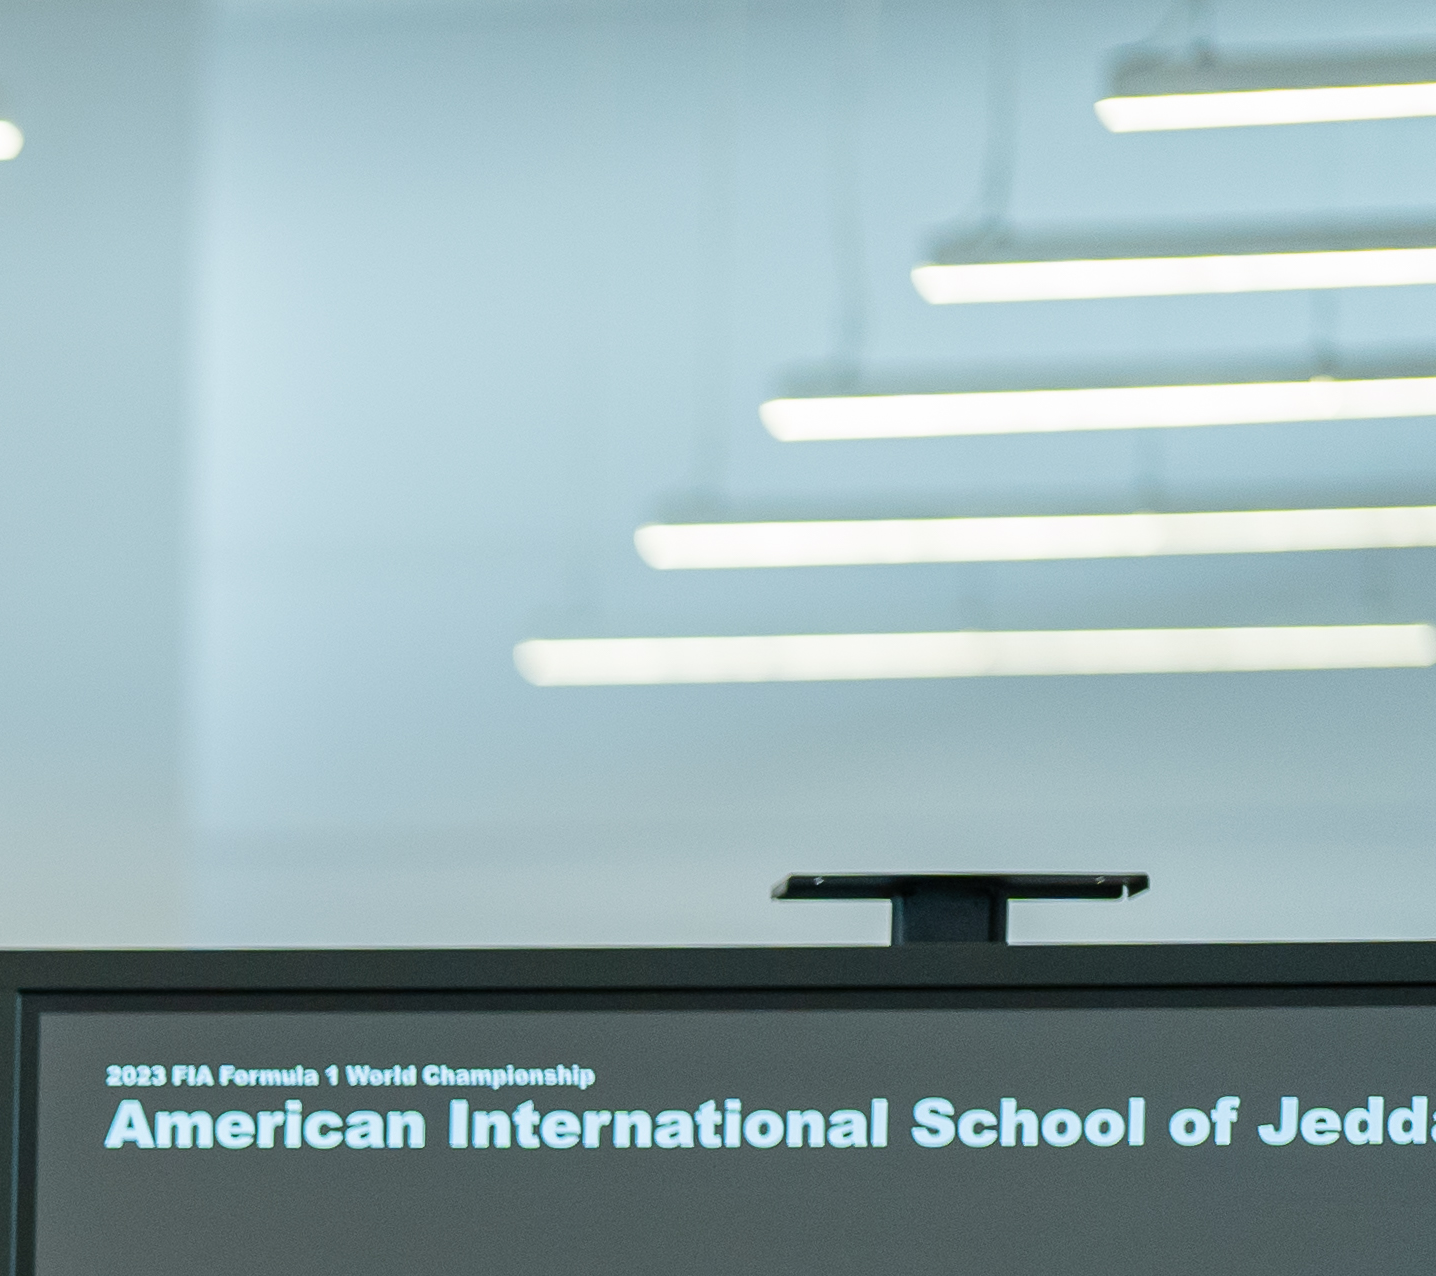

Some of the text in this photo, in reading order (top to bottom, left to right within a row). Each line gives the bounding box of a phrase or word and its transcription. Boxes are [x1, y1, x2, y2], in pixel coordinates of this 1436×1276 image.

[105, 1064, 597, 1091] 2023 FIA Formula 1 World Championship
[103, 1095, 1436, 1150] American International School of Jedd
